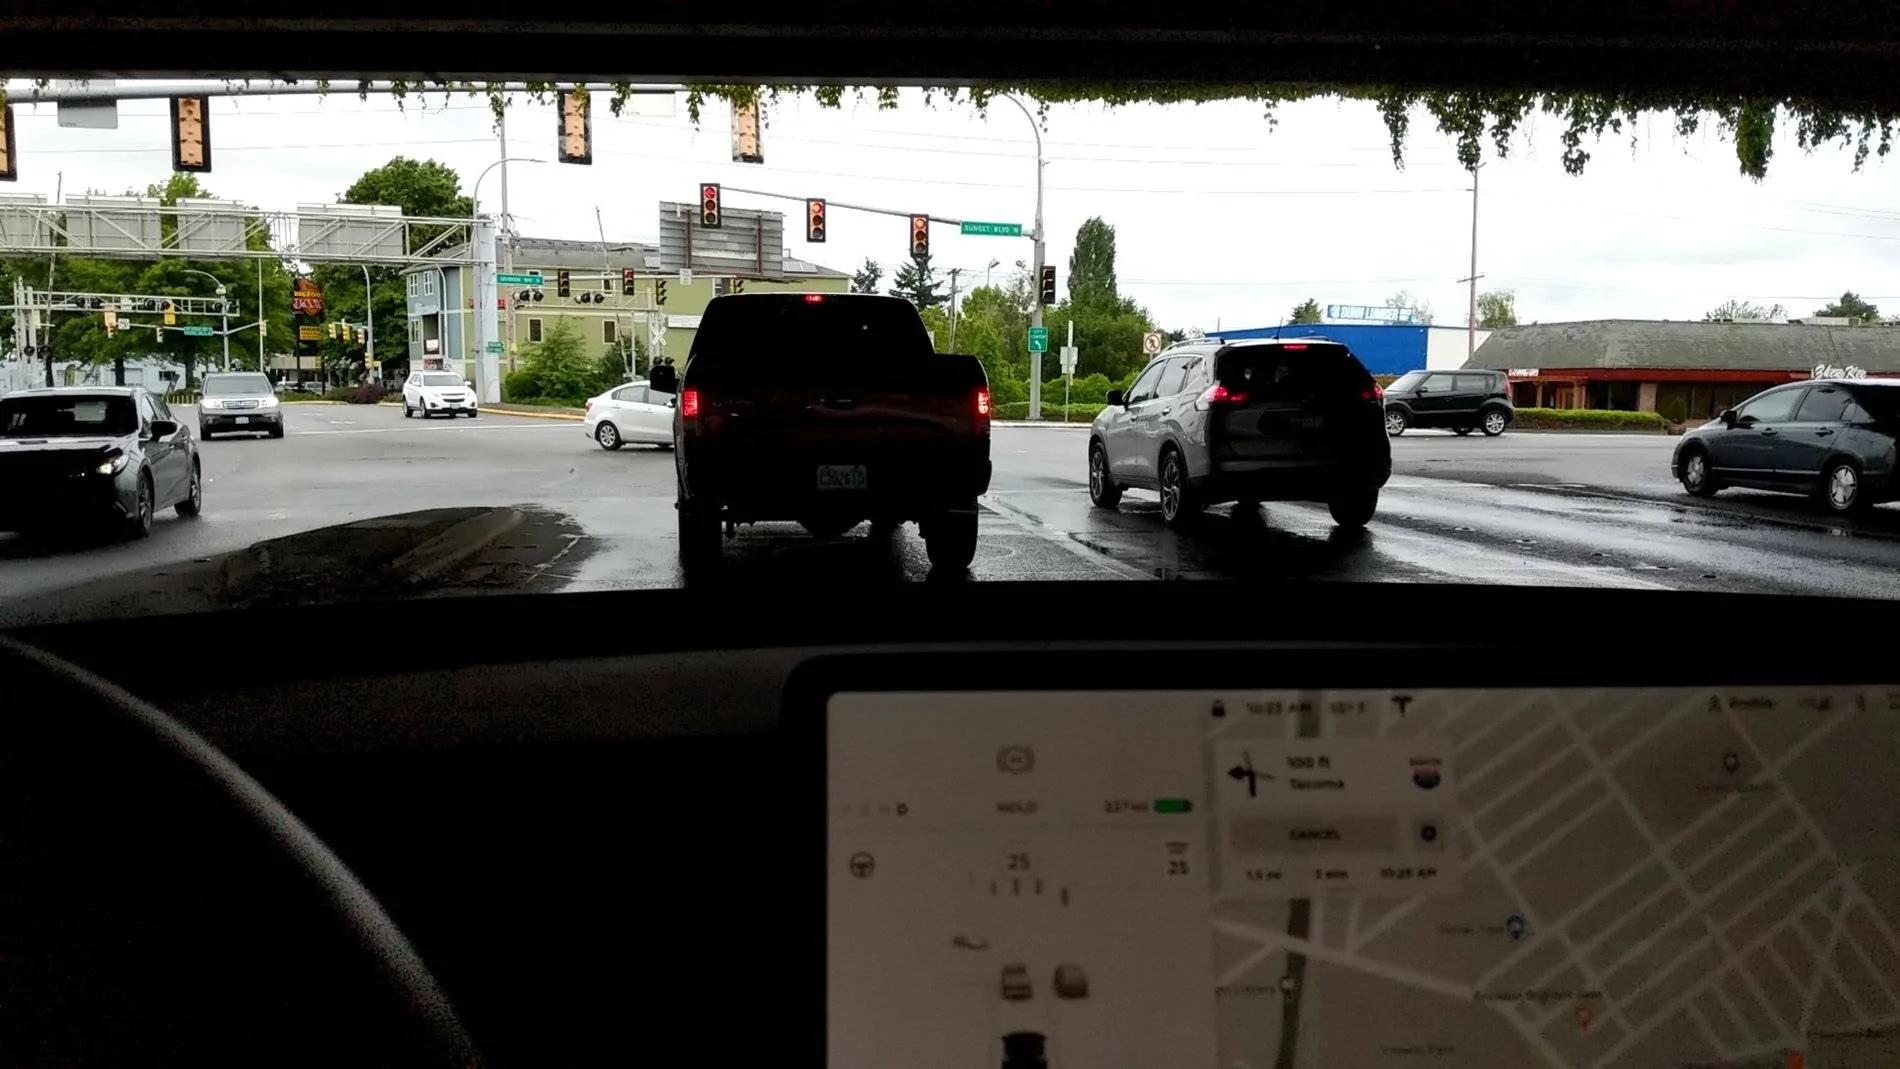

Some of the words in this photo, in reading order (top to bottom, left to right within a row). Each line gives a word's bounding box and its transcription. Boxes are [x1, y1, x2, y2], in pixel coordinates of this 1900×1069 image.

[963, 223, 990, 233] SUNSET
[993, 225, 1010, 234] BLVD
[1365, 307, 1399, 322] LUMBER
[1289, 777, 1345, 791] Tacoma
[996, 800, 1039, 814] HOLD
[1288, 828, 1342, 842] CANCEL
[1006, 851, 1032, 871] 25
[1167, 859, 1192, 876] 25
